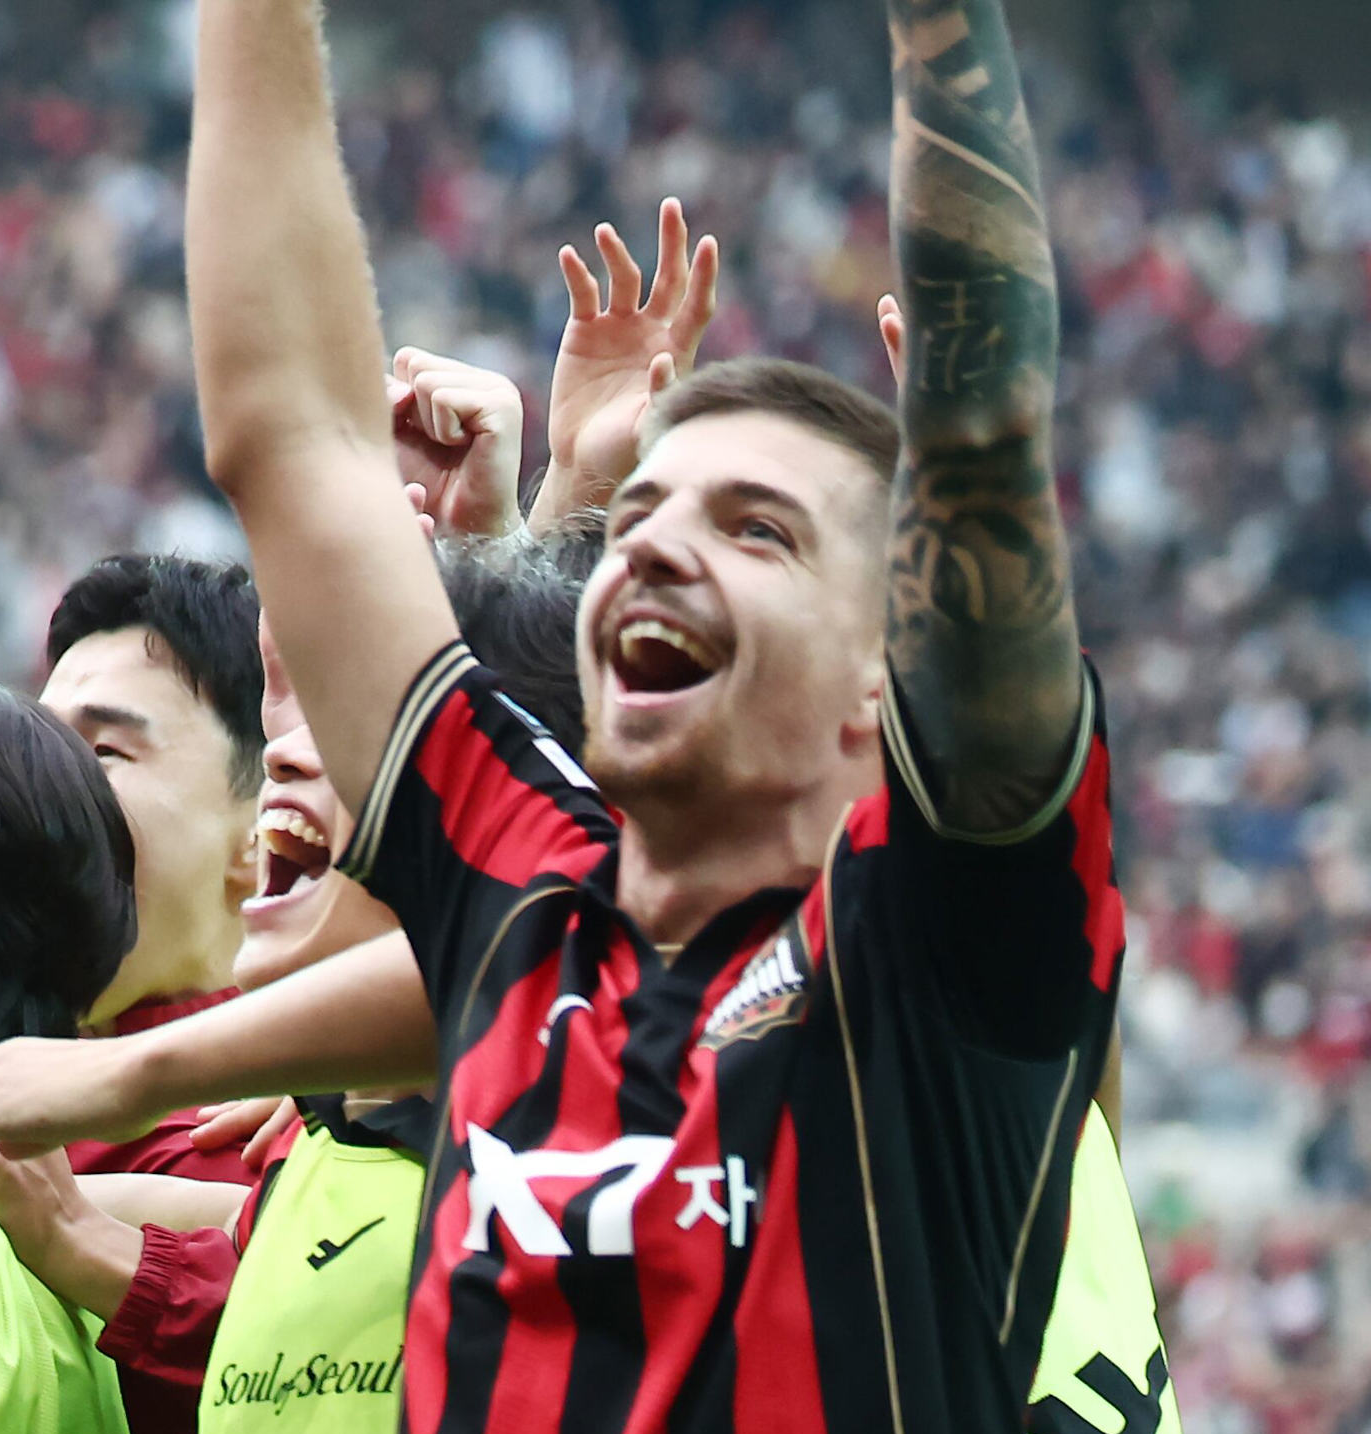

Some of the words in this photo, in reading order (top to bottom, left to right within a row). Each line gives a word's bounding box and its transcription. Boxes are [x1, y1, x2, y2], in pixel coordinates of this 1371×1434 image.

[675, 1155, 765, 1248] 자
[214, 1352, 285, 1407] Soul
[297, 1344, 406, 1398] Seoul
